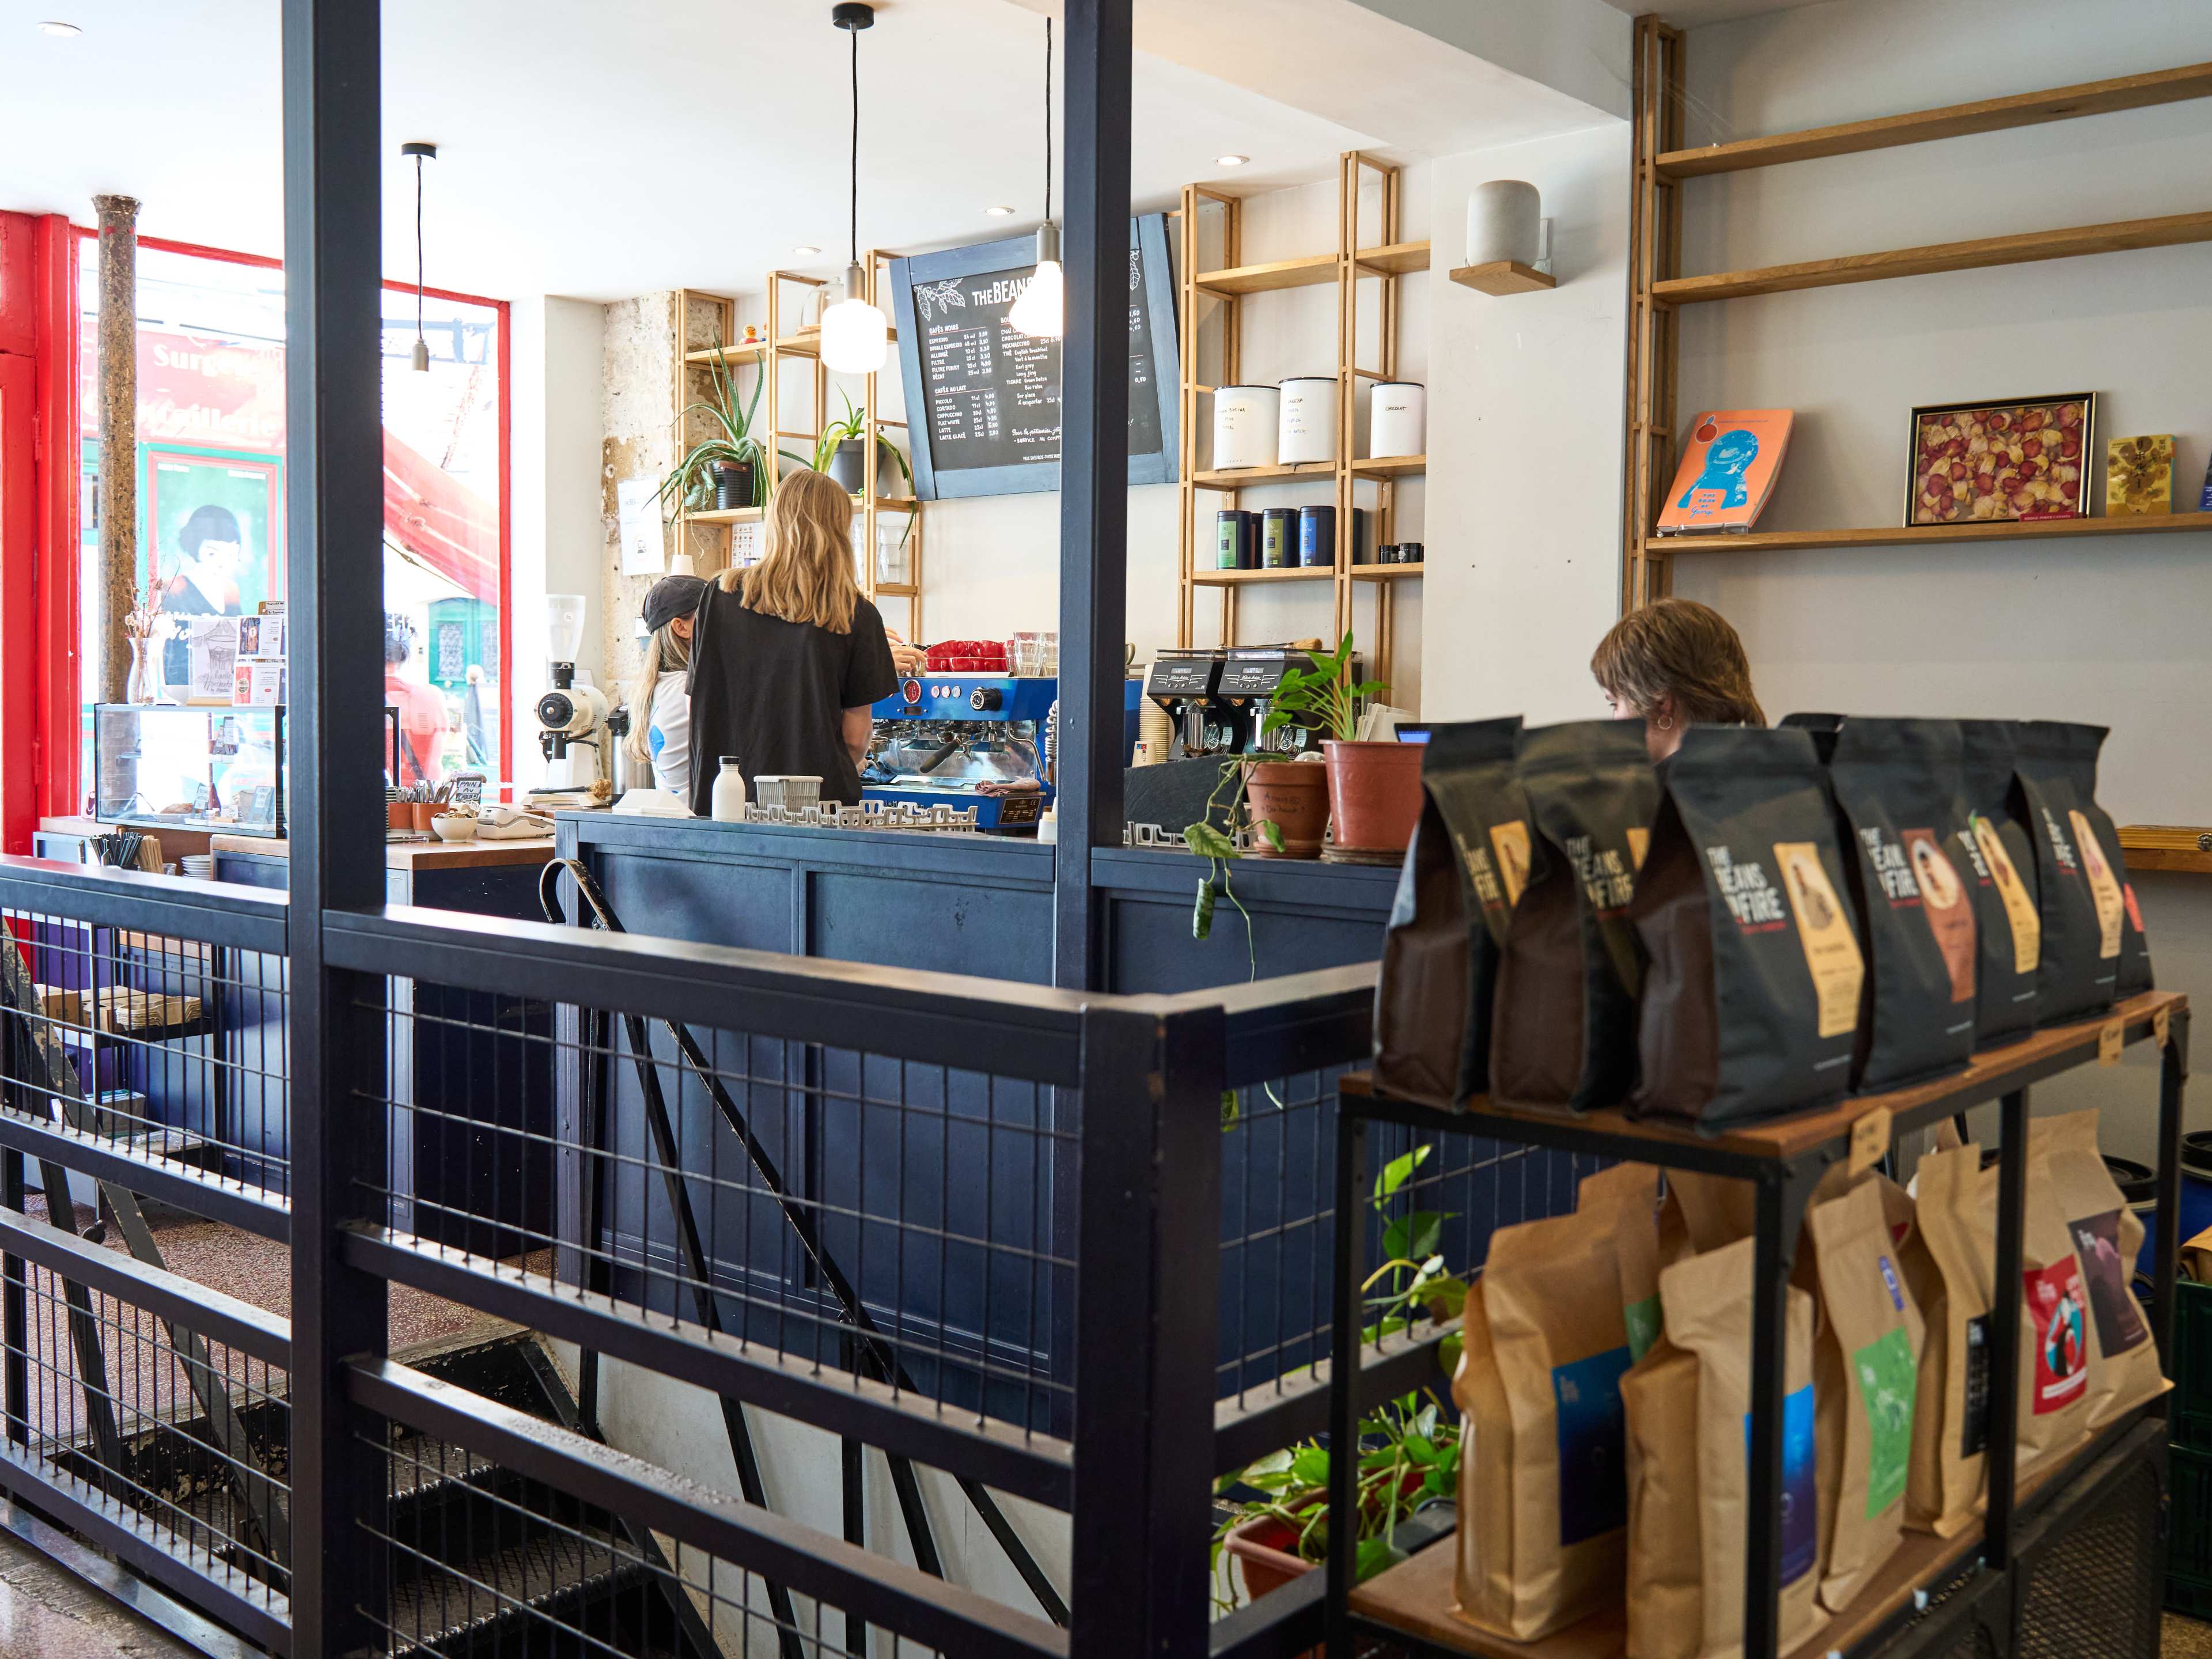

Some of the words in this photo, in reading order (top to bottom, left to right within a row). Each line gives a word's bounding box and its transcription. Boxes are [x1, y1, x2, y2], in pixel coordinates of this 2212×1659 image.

[972, 289, 993, 306] THE
[945, 324, 959, 332] NOIRS
[1002, 340, 1030, 349] MOCHACCINO
[1022, 398, 1042, 407] emporter
